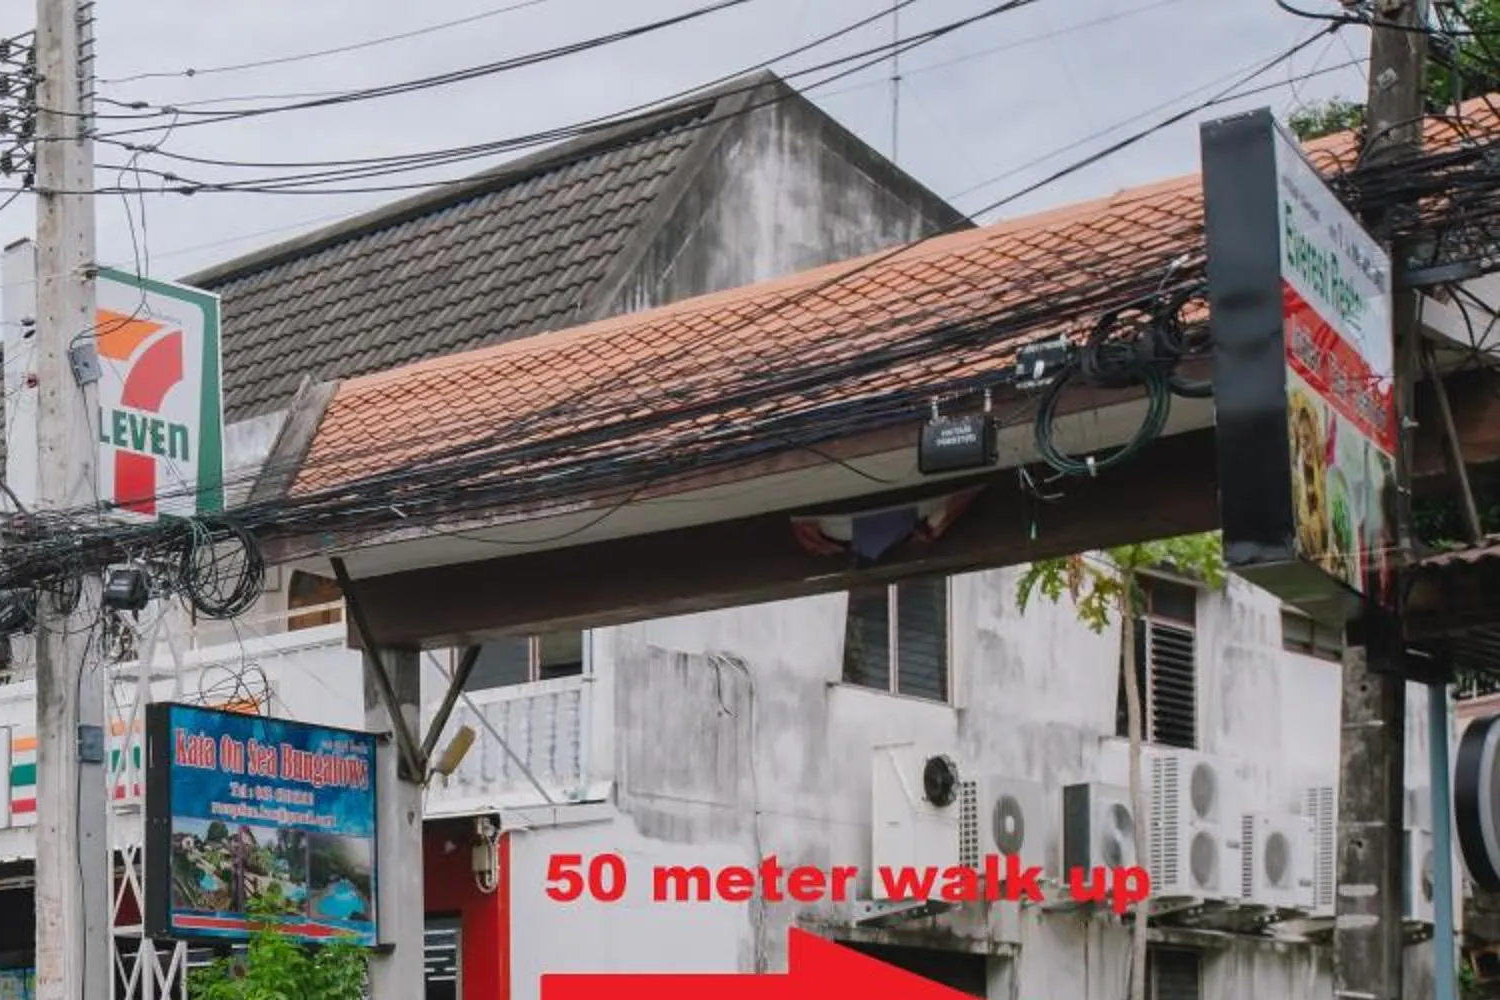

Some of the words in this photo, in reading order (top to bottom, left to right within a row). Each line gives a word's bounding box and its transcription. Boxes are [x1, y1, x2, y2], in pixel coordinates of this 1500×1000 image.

[99, 404, 190, 462] LEVEn
[175, 728, 216, 769] Kata
[220, 734, 245, 775] On
[247, 737, 277, 778] Sea
[280, 742, 369, 790] Bungalows
